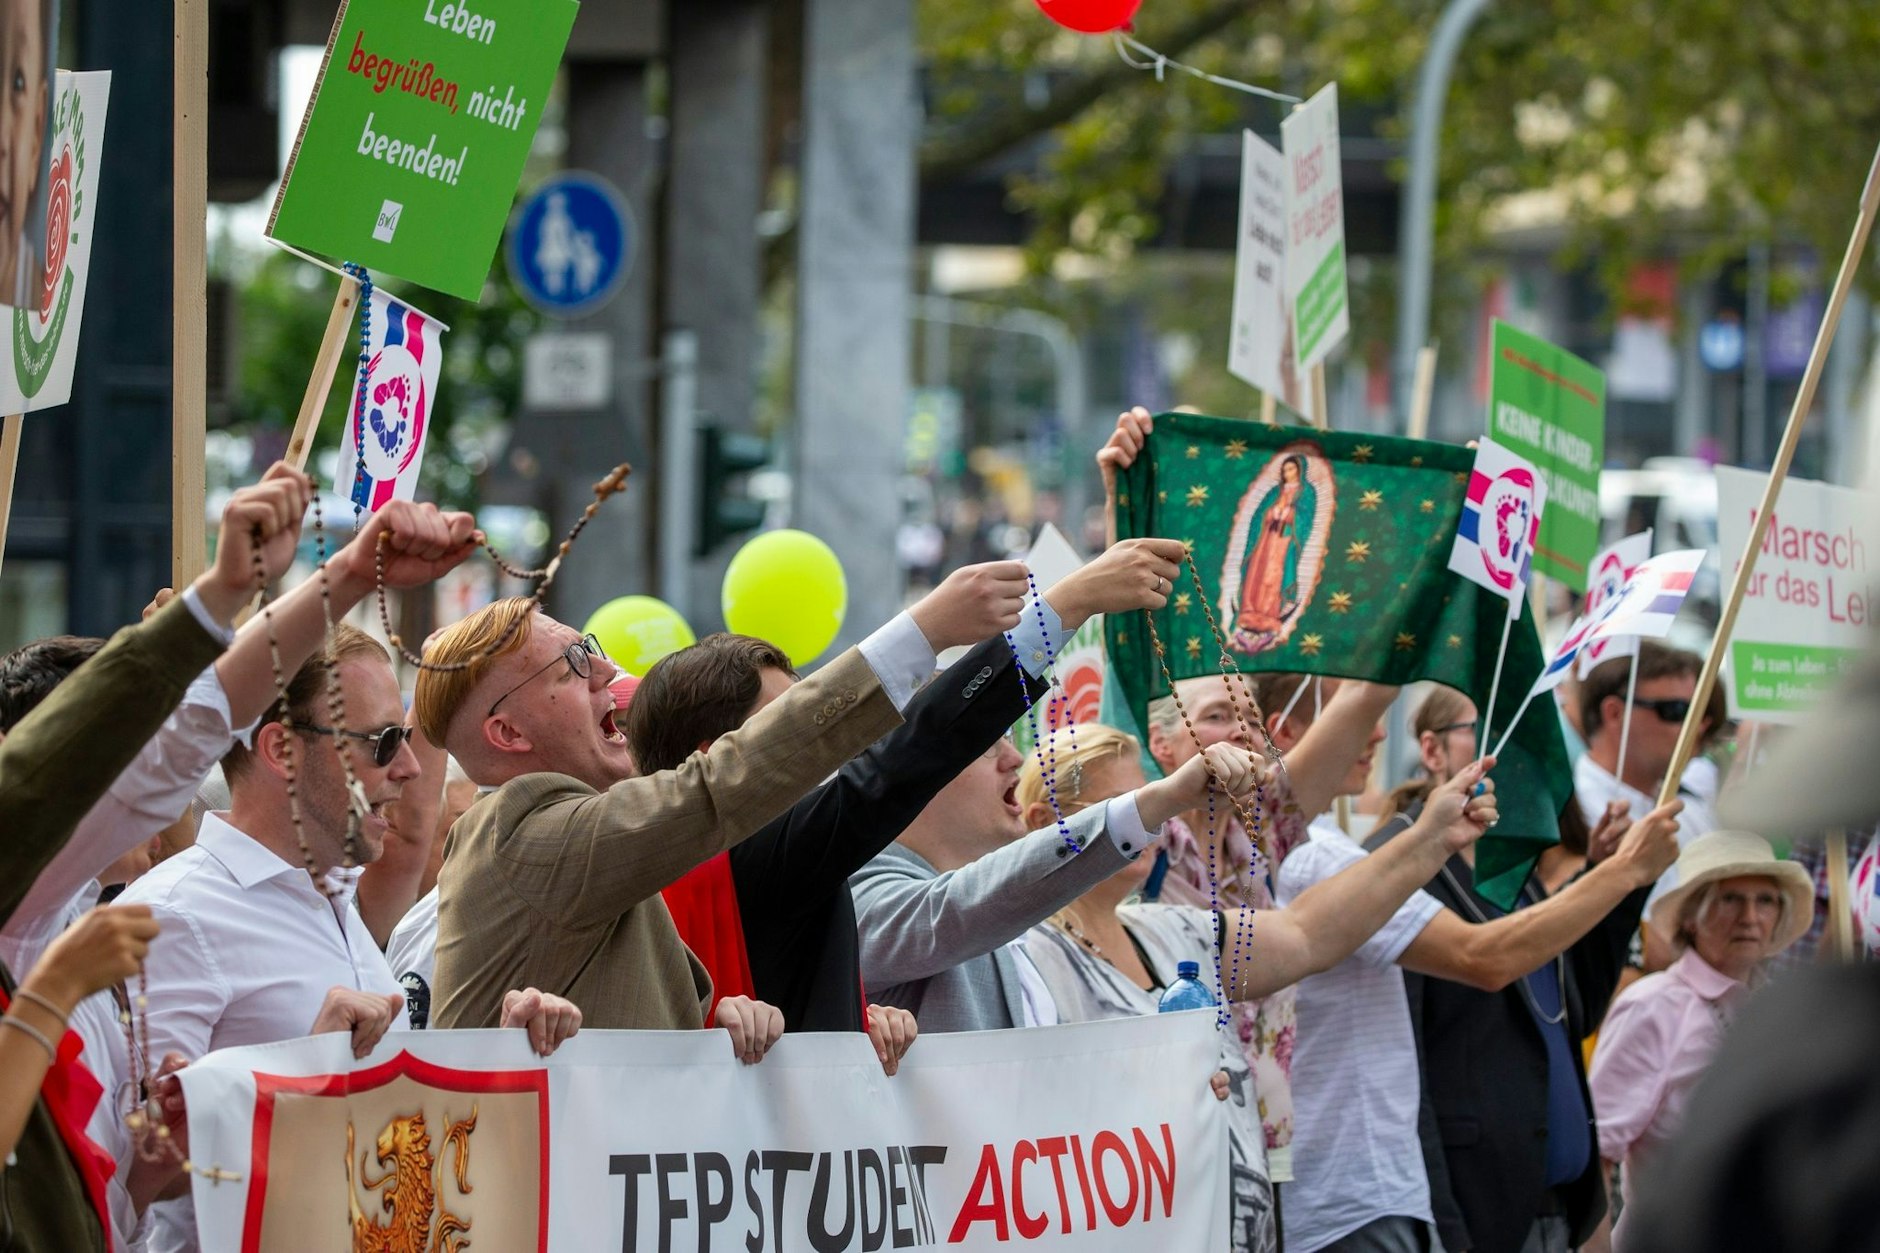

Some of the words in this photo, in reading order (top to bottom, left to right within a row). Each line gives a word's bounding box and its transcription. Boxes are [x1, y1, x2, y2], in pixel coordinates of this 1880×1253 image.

[423, 0, 496, 45] Leben
[347, 30, 458, 115] begrüßen,
[466, 84, 527, 131] nicht
[357, 112, 468, 186] beenden!
[1775, 567, 1820, 608] das
[608, 1151, 734, 1253] TFP
[947, 1123, 1176, 1243] ACTION
